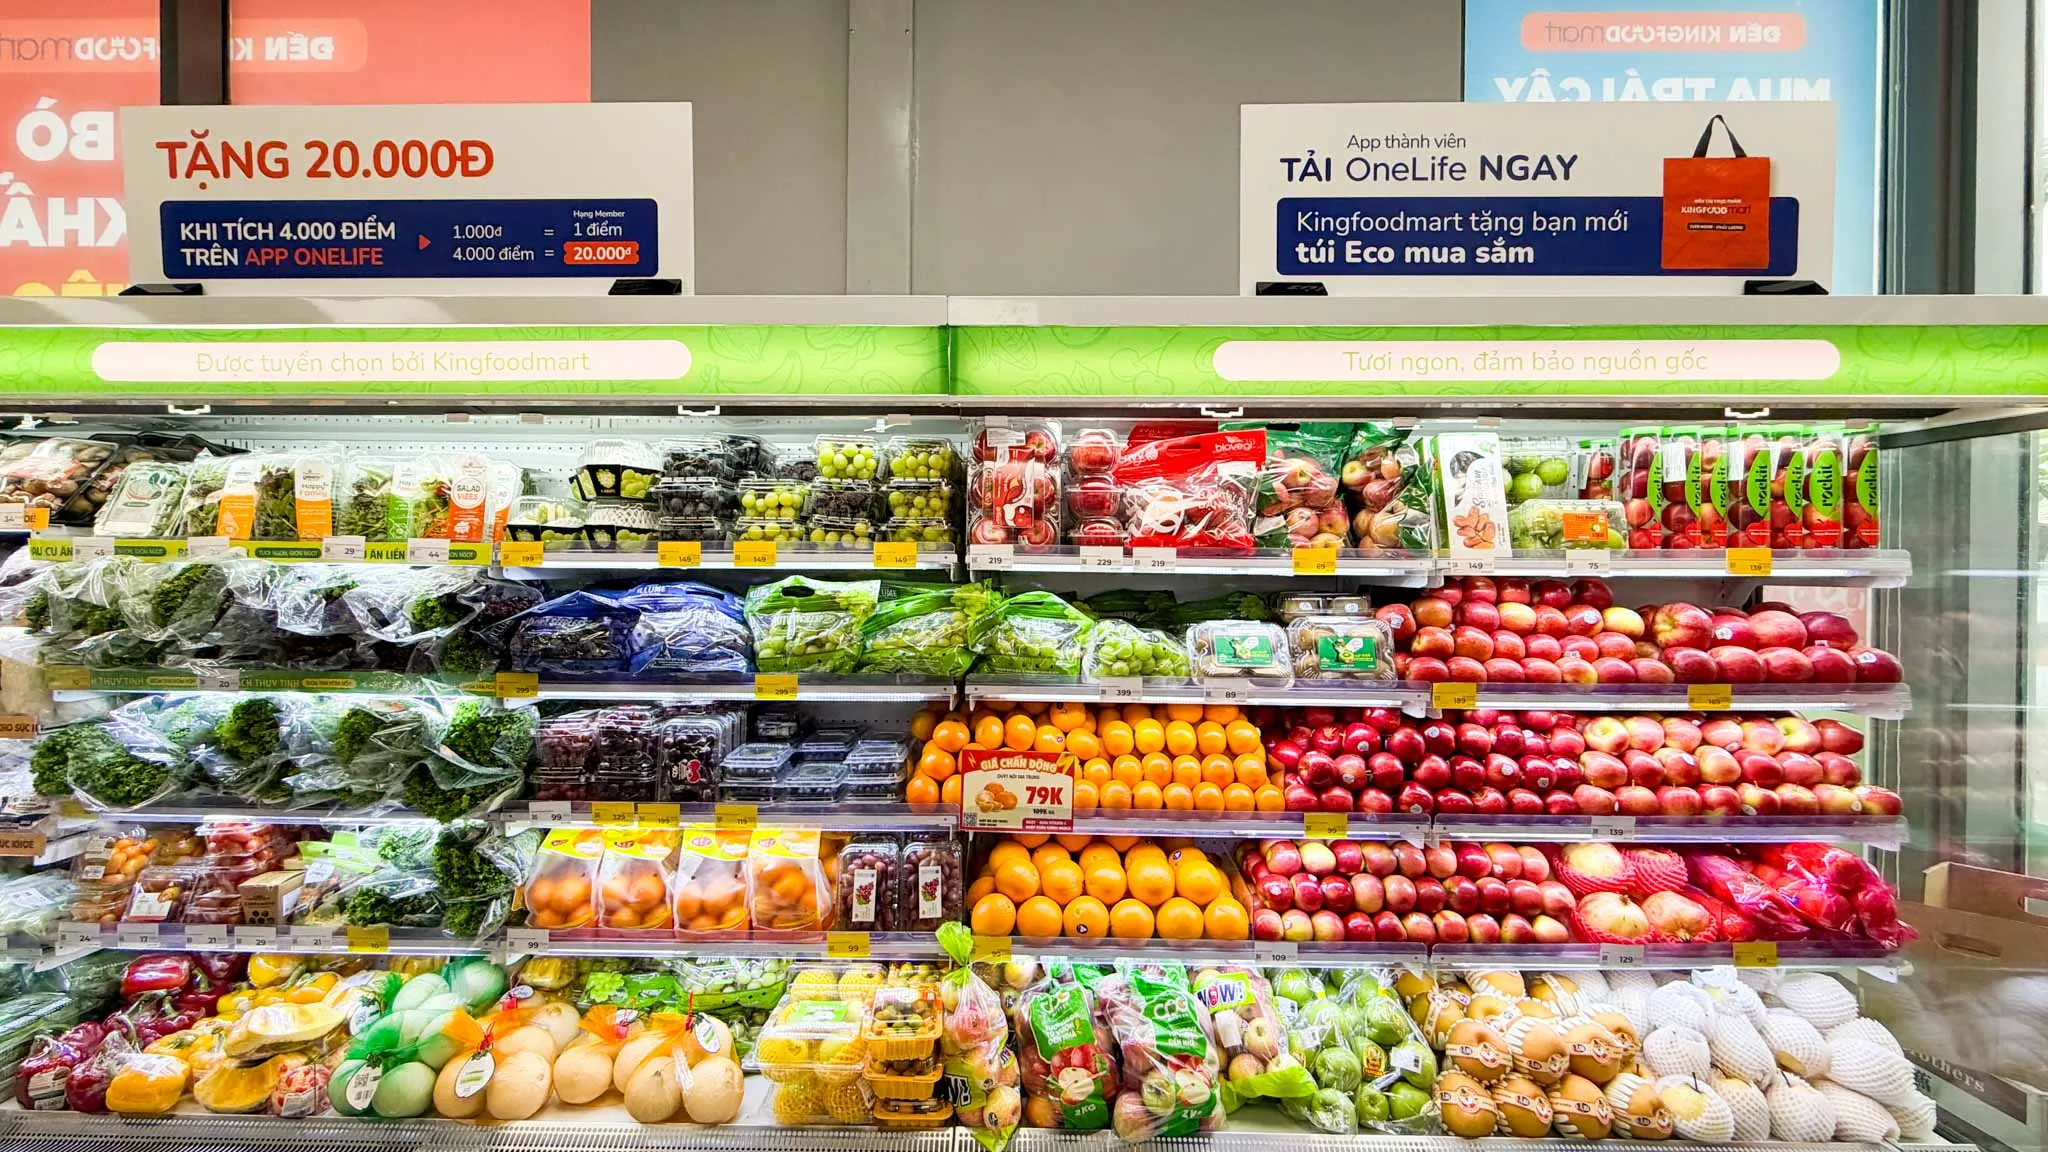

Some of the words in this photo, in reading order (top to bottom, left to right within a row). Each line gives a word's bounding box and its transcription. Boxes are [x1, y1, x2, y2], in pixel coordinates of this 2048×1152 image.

[1347, 134, 1381, 152] App
[1385, 133, 1430, 149] thành
[1434, 133, 1467, 149] viên
[155, 128, 291, 190] TẶNG
[304, 139, 494, 179] 20.000Đ
[1279, 149, 1332, 183] TẢI
[1346, 156, 1467, 183] OneLife
[1479, 154, 1578, 182] NGAY
[573, 210, 594, 219] Hạng
[594, 209, 626, 218] Member
[180, 221, 217, 242] KHI
[222, 216, 274, 242] TÍCH
[279, 222, 336, 241] 4.000
[340, 214, 396, 241] ĐIỂM
[1296, 210, 1464, 238] Kingfoodmart
[1469, 209, 1525, 239] tặng
[1531, 210, 1576, 238] bạn
[1585, 210, 1630, 232] mới
[453, 224, 503, 240] 1.000đ
[573, 222, 583, 237] 1
[586, 220, 623, 237] điểm
[180, 242, 239, 267] TRÊN
[244, 247, 289, 266] APP
[294, 247, 384, 266] ONELIFE
[452, 246, 495, 261] 4.000
[498, 244, 535, 262] điểm
[573, 245, 633, 261] 20.000đ
[1296, 238, 1335, 264] túi
[1345, 240, 1395, 264] Eco
[1404, 245, 1467, 264] mua
[1475, 236, 1536, 264] sắm
[194, 351, 256, 377] Được
[330, 352, 384, 378] chọn
[391, 348, 426, 373] bởi
[432, 351, 590, 377] Kingfoodmart
[1343, 349, 1394, 373] Tươi
[1400, 354, 1466, 376] ngon,
[1472, 348, 1525, 373] đảm
[1531, 349, 1576, 372] bảo
[1582, 348, 1658, 377] nguồn
[1664, 347, 1709, 376] gốc
[456, 484, 481, 492] SALAD
[1755, 465, 1769, 507] rockit
[1817, 464, 1833, 507] rockit
[344, 547, 355, 555] 29
[988, 557, 1002, 565] 219
[1096, 558, 1112, 566] 229
[1151, 559, 1166, 567] 219
[1468, 561, 1483, 570] 149
[1588, 562, 1599, 570] 75
[219, 680, 230, 688] 20
[775, 688, 789, 696] 299
[1115, 689, 1131, 697] 399
[1225, 690, 1237, 699] 89
[980, 756, 999, 771] GIÁ
[1000, 754, 1027, 769] CHẤN
[1029, 757, 1058, 774] ĐỘNG
[1025, 785, 1065, 806] 79K
[551, 813, 563, 821] 99
[1609, 828, 1624, 836] 139
[79, 935, 91, 943] 24
[255, 938, 266, 946] 29
[313, 938, 322, 946] 21
[527, 941, 539, 949] 99
[1272, 953, 1287, 962] 109
[1619, 956, 1633, 964] 129
